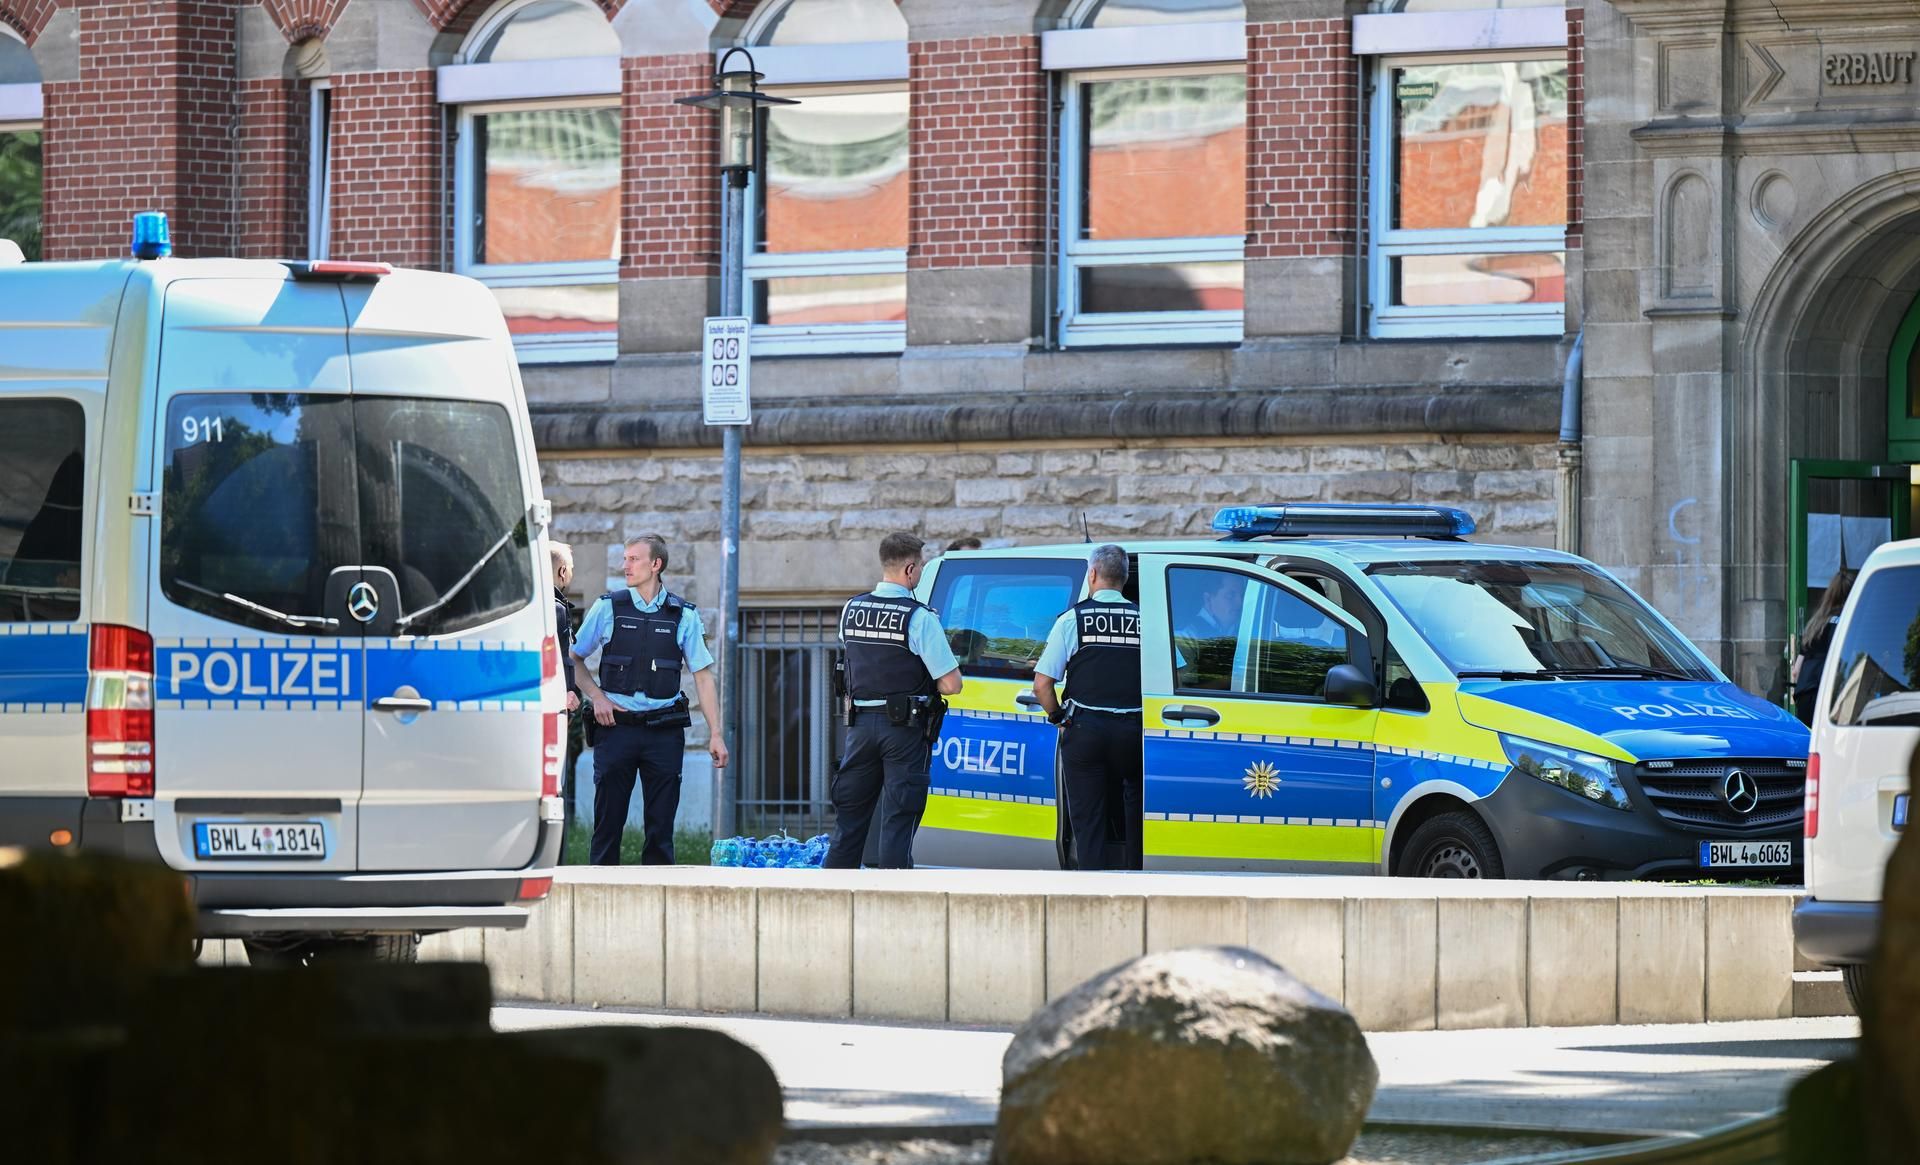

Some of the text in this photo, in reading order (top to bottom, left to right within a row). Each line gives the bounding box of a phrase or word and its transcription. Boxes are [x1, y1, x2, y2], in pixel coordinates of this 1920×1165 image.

[1825, 51, 1917, 86] ERBAUT
[182, 415, 223, 442] 911
[846, 609, 905, 631] POLIZEI
[1083, 615, 1141, 635] POLIZE
[170, 651, 350, 696] POLIZEI
[1611, 703, 1760, 721] POLIZEI
[210, 828, 246, 851] BWL
[275, 828, 321, 851] 1814
[1710, 845, 1737, 864] BWL
[1758, 844, 1789, 863] 6063
